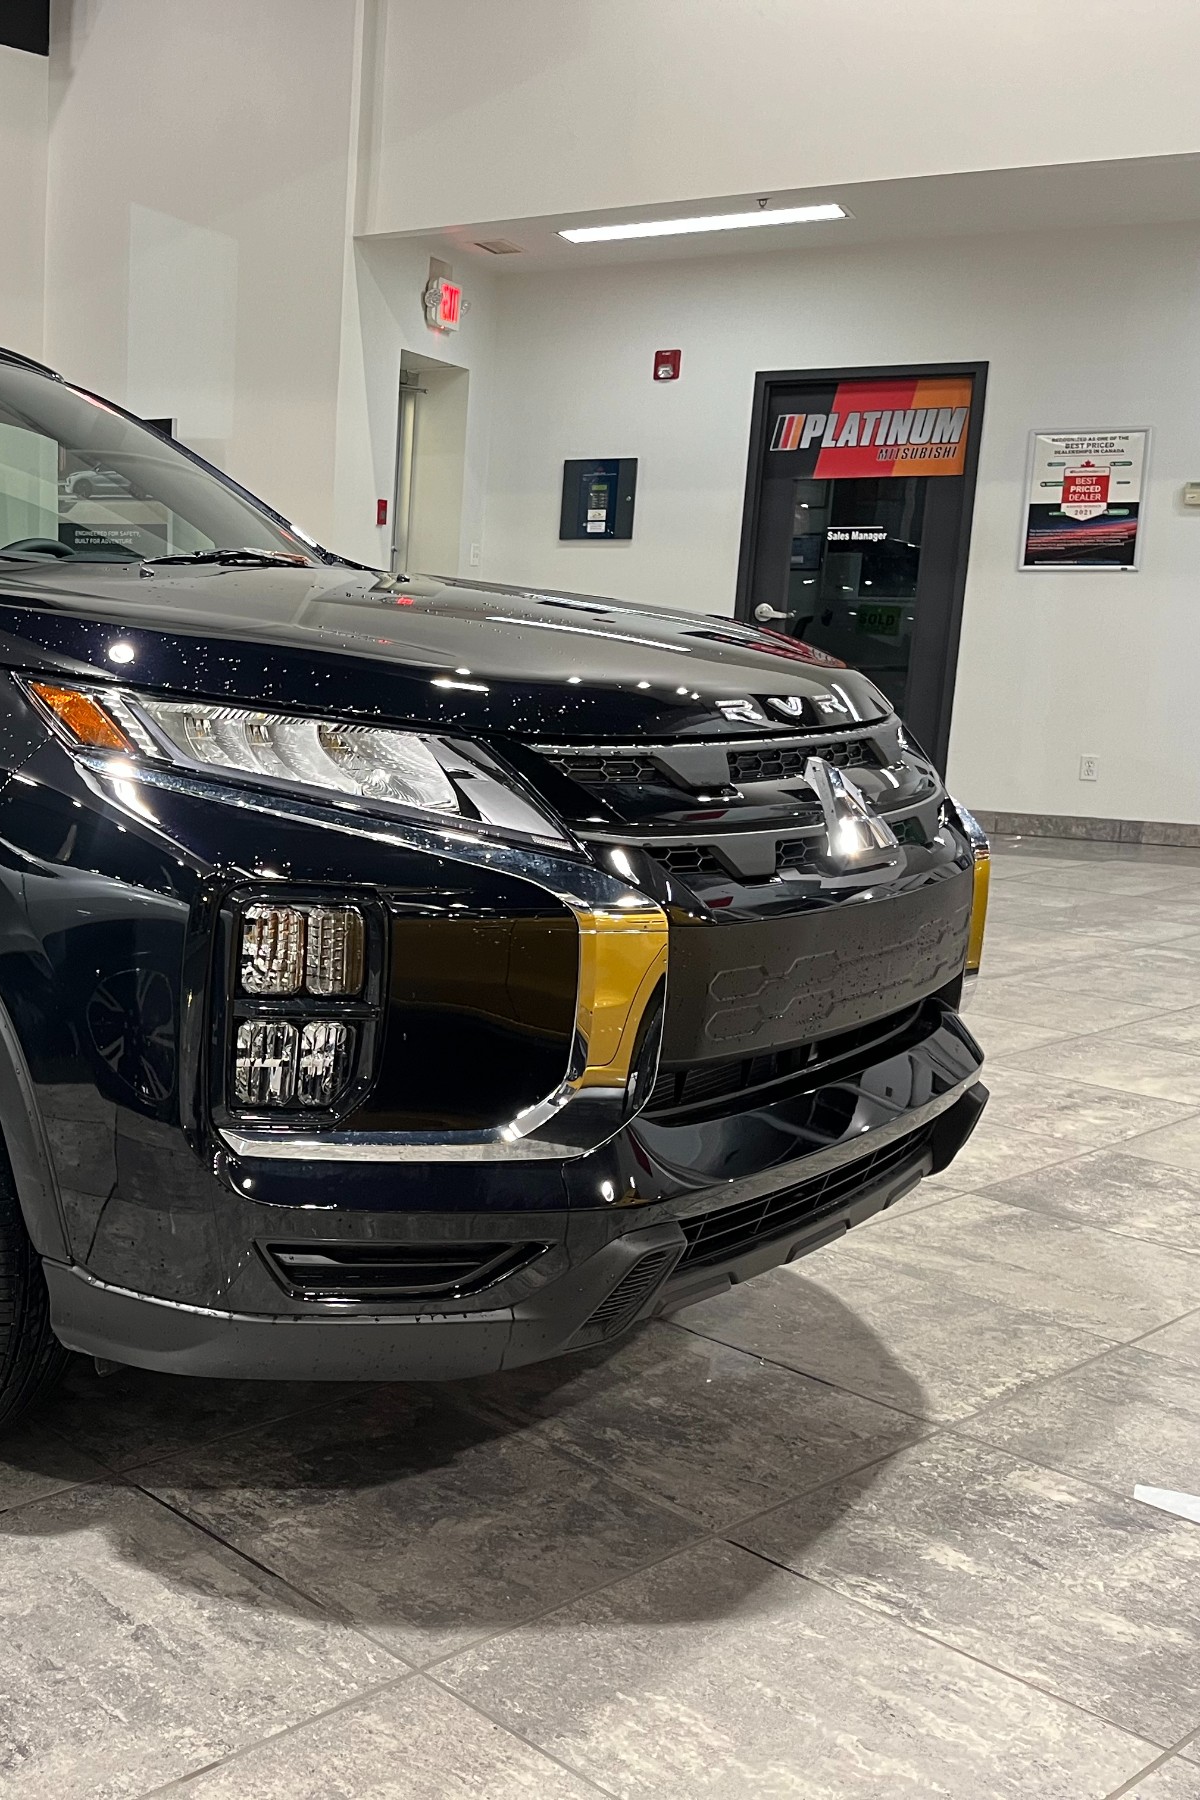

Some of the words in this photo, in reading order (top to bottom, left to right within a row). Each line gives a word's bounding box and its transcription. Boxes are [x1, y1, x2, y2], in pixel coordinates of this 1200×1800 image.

[800, 407, 969, 449] PLATINUM
[876, 446, 957, 461] MITSUBISHI
[1075, 477, 1097, 485] BEST
[1070, 485, 1102, 493] PRICED
[1068, 493, 1102, 501] DEALER
[827, 531, 850, 541] Sales
[851, 531, 888, 542] Manager
[859, 613, 895, 625] SOLD
[714, 693, 849, 721] RVR
